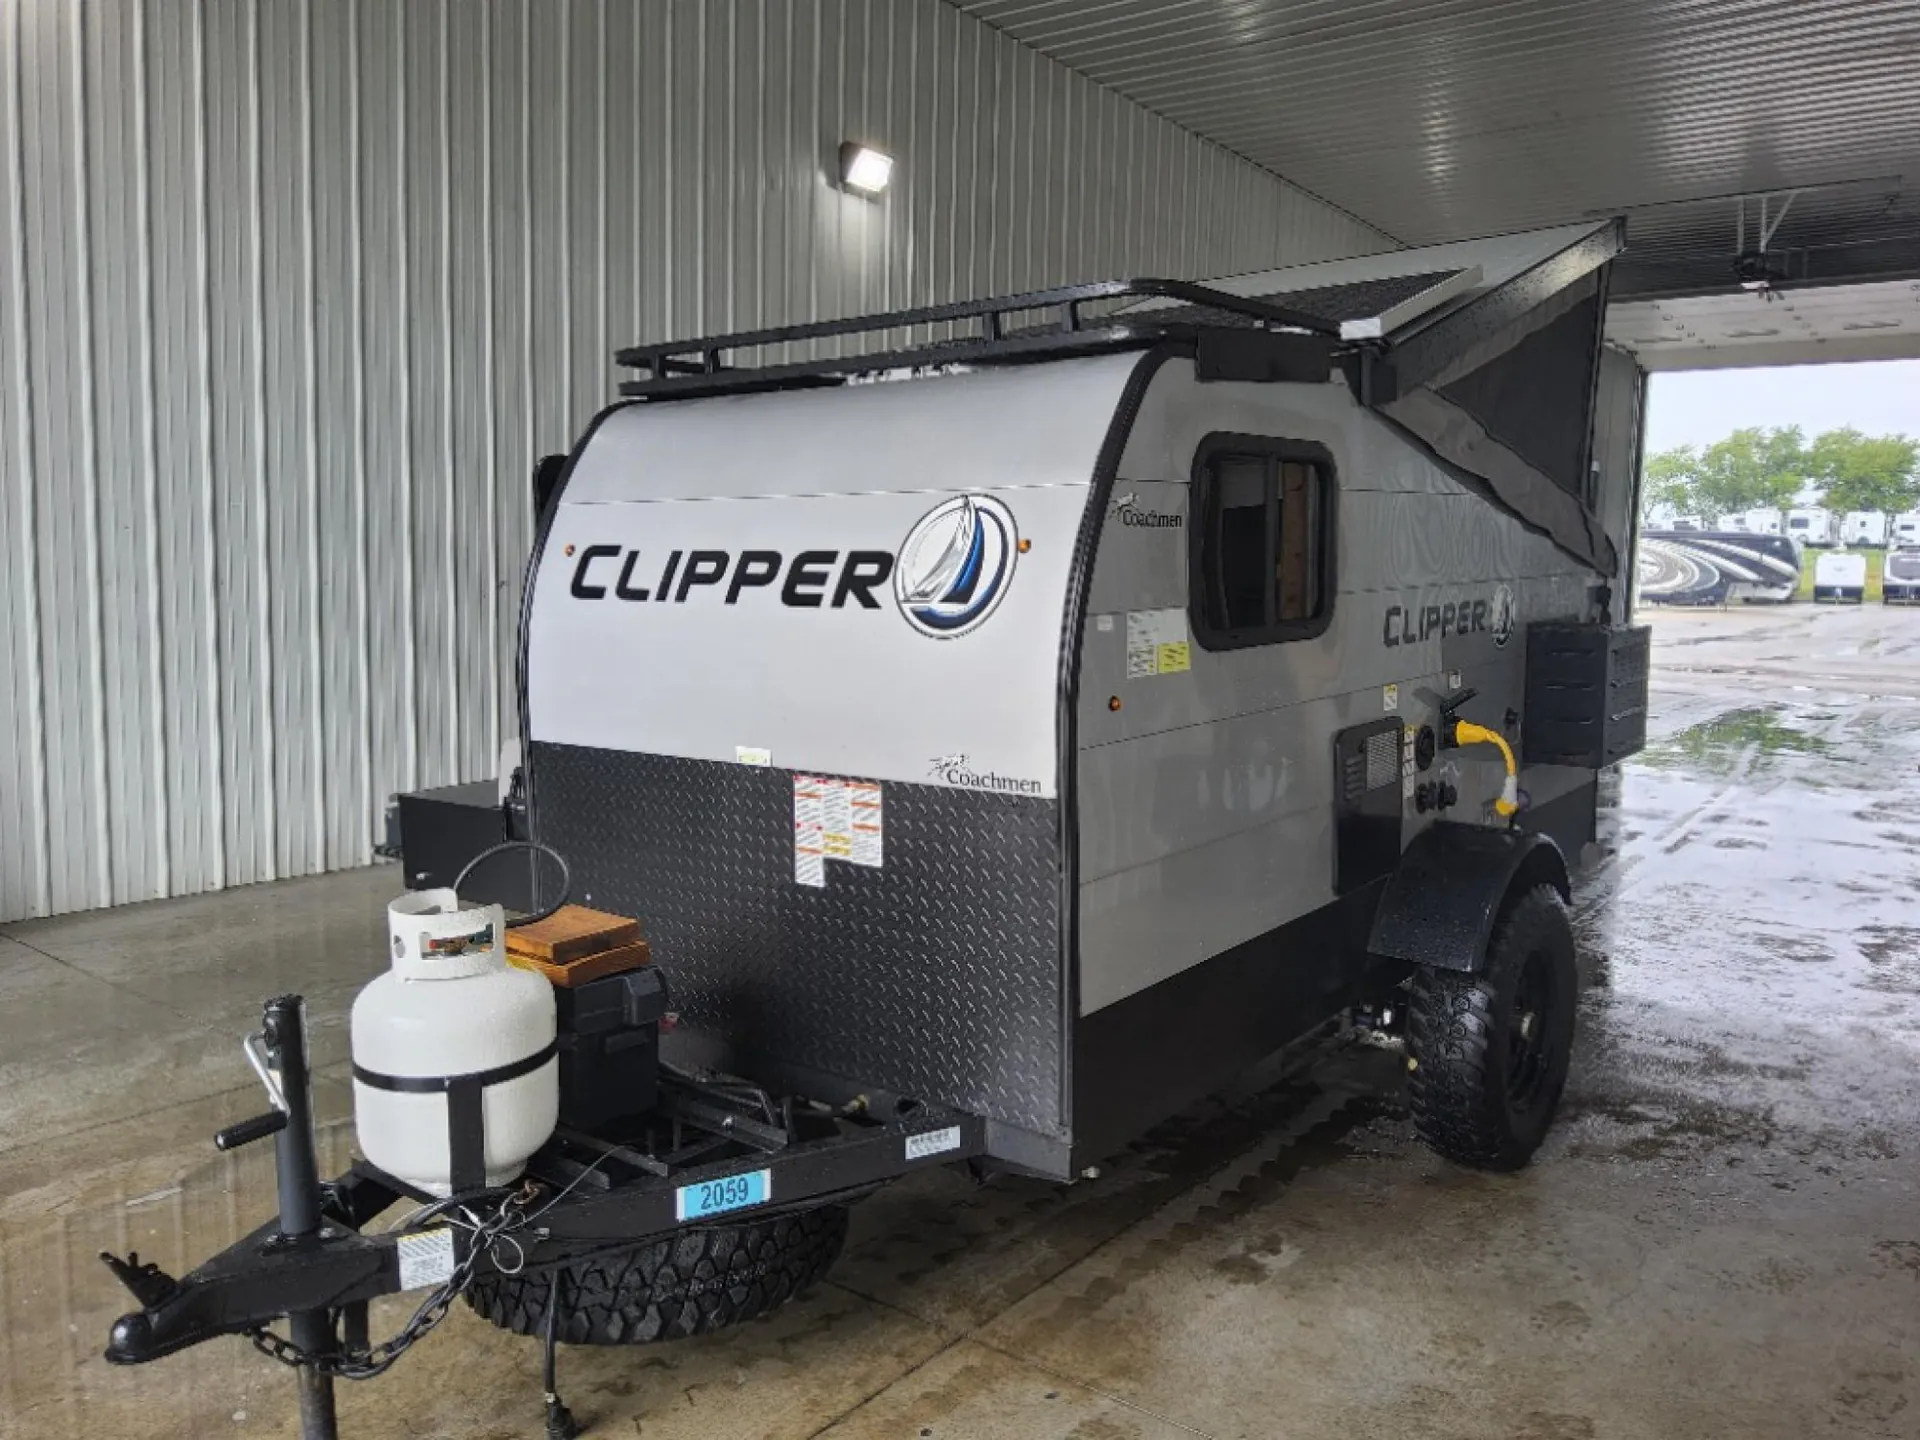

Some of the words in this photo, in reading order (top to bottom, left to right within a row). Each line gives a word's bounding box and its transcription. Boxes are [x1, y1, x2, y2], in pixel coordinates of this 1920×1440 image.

[1123, 508, 1183, 528] Coachmen
[570, 544, 894, 609] CLIPPER
[1383, 599, 1488, 647] CLIPPER
[946, 768, 1042, 794] Coachmen
[700, 1177, 749, 1209] 2059
